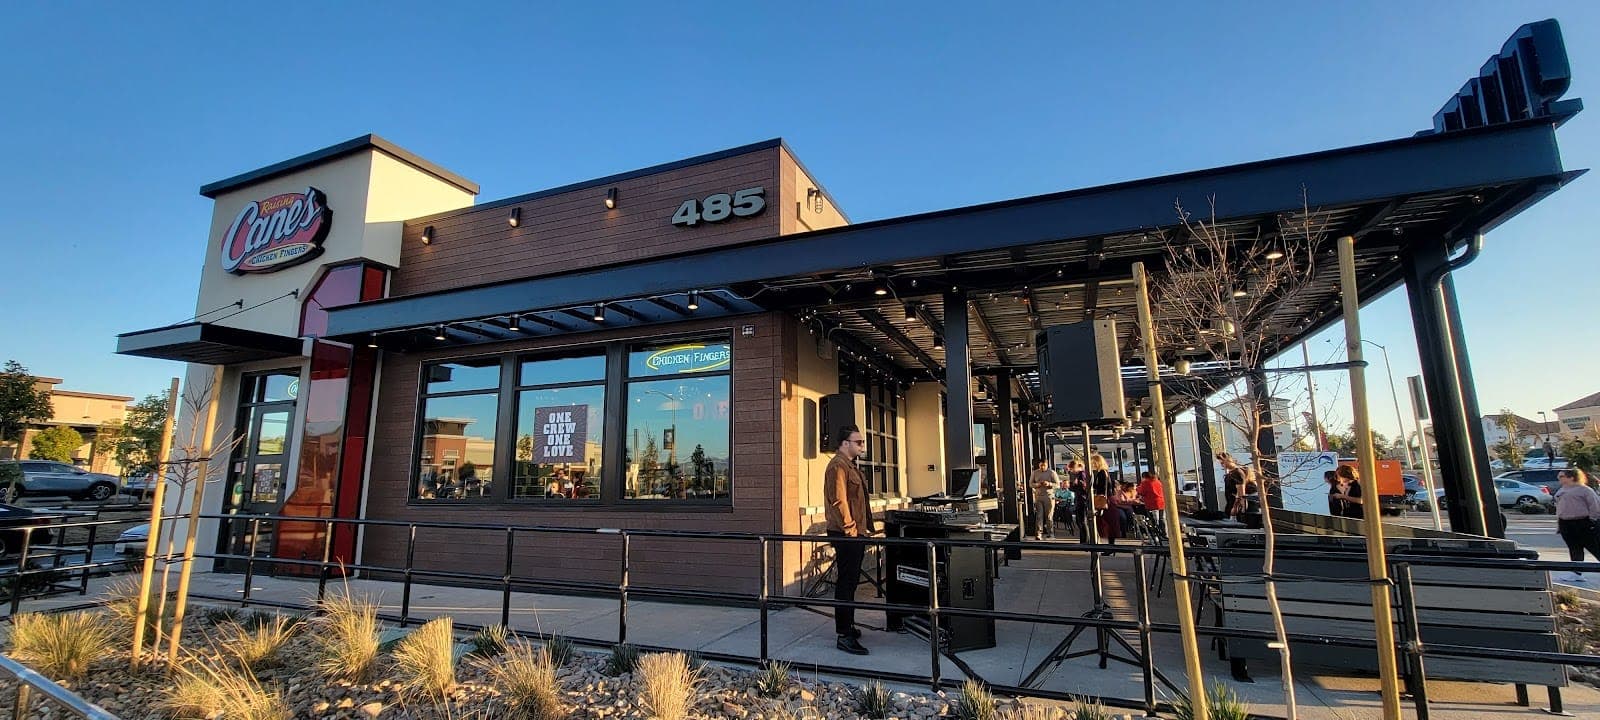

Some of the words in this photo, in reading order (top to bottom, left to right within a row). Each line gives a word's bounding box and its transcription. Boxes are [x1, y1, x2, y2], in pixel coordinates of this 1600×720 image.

[672, 186, 765, 226] 485
[222, 186, 321, 271] Cane's
[652, 354, 690, 366] CHICKEN
[694, 350, 730, 362] FINGERS
[548, 411, 572, 423] ONE
[543, 422, 577, 435] CREW
[547, 434, 571, 446] ONE
[543, 444, 574, 457] LOVE
